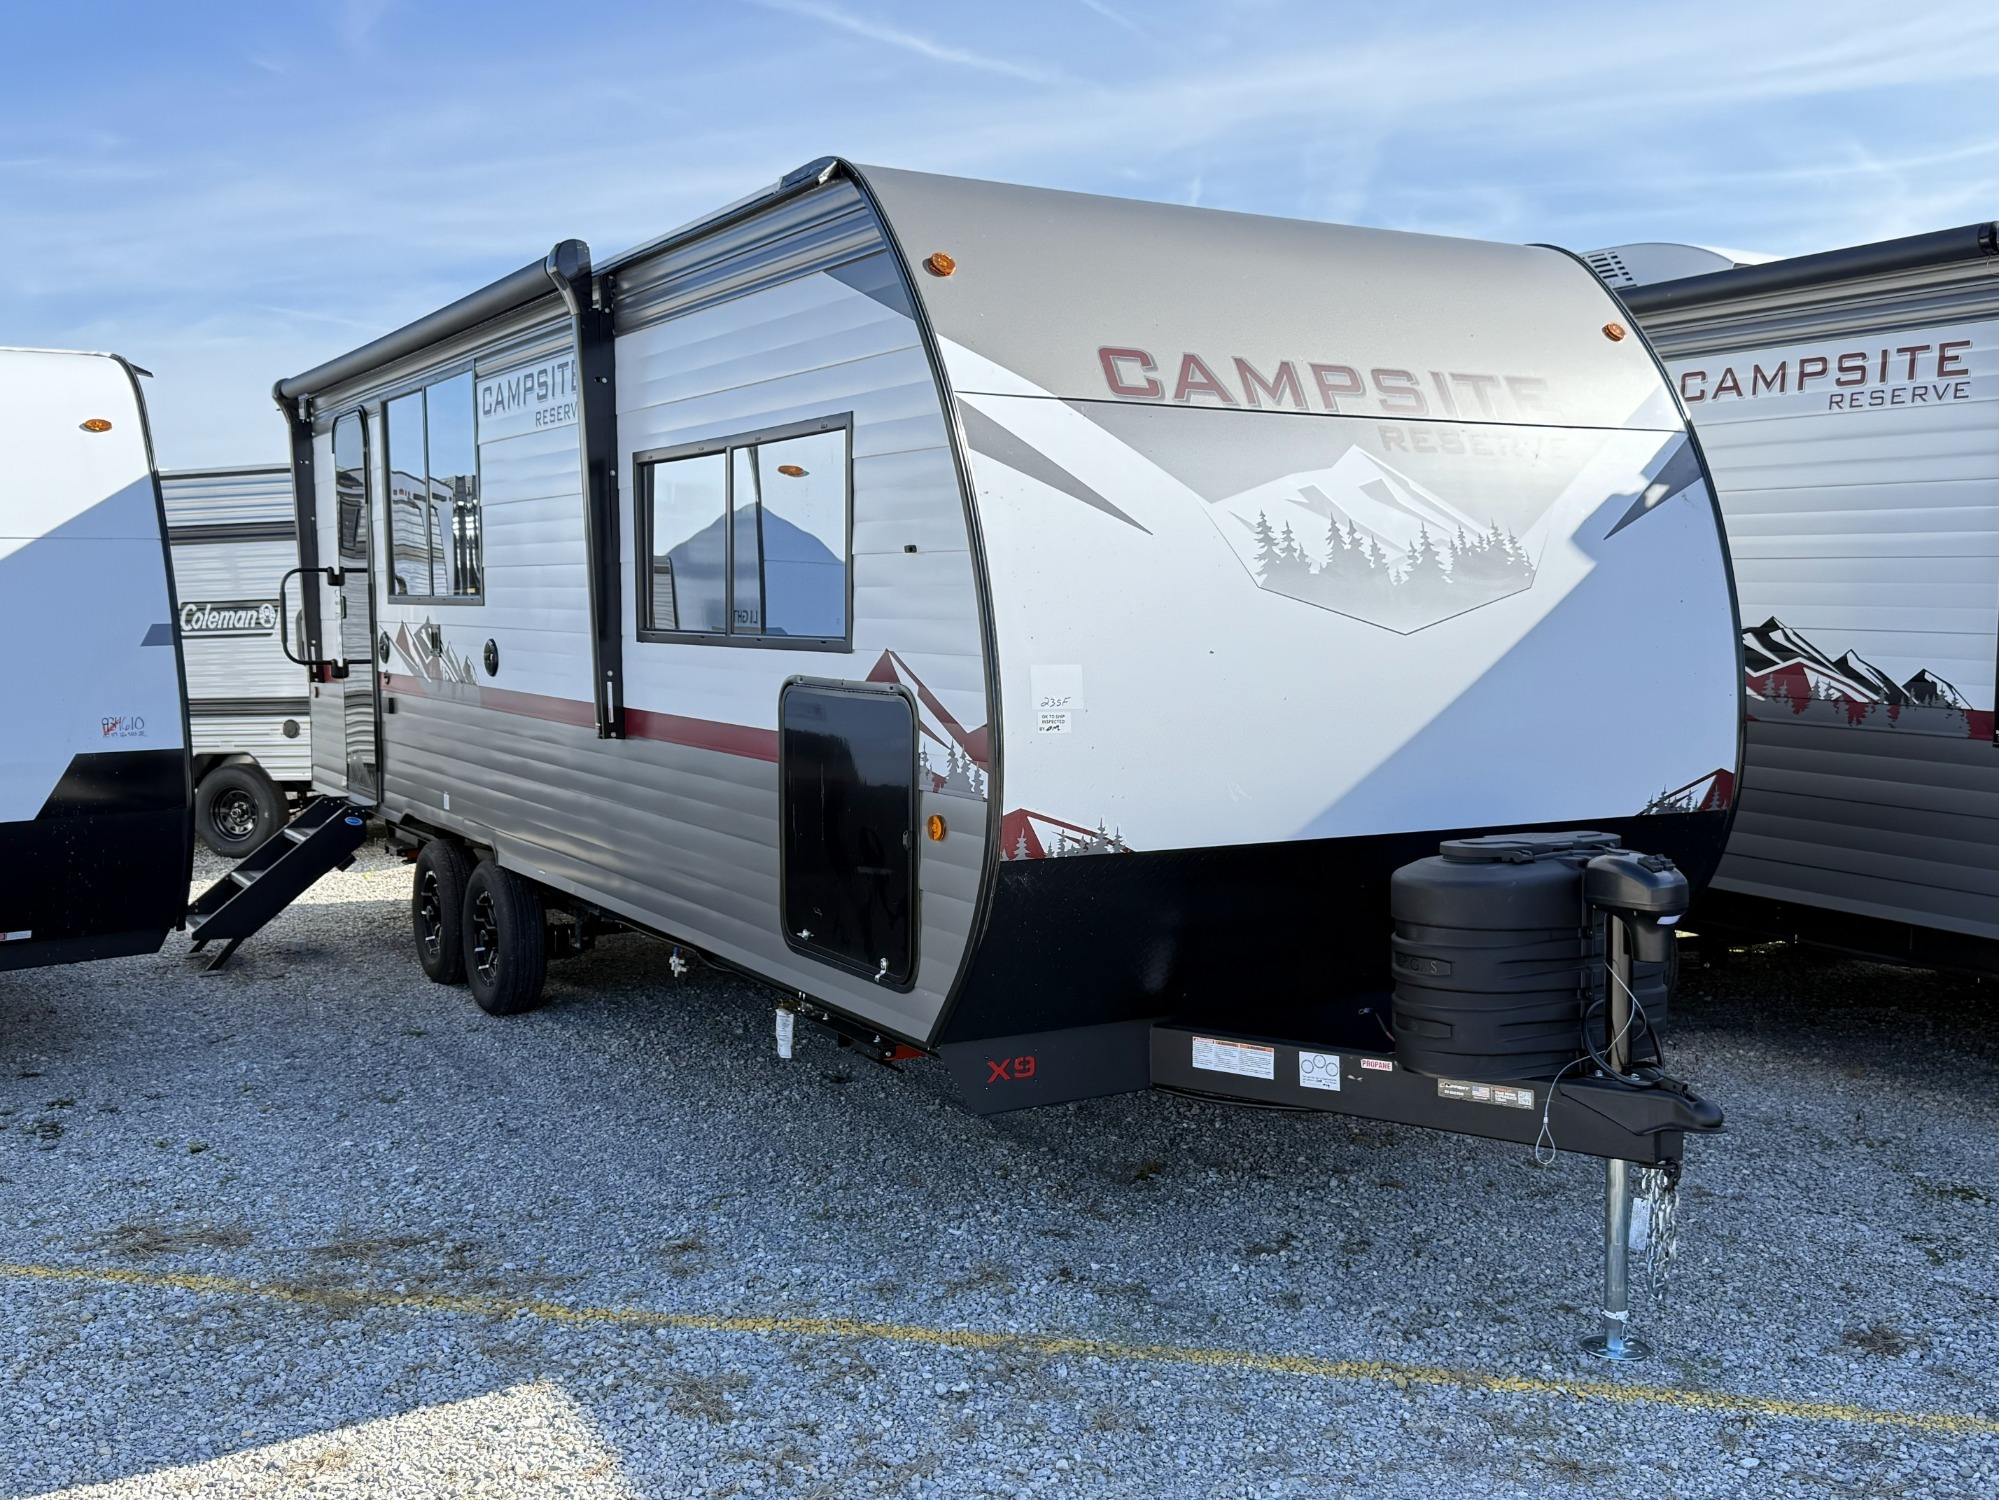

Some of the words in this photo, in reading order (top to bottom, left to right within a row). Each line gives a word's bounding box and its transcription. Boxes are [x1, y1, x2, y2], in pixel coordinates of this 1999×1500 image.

[1098, 346, 1560, 421] CAMPSITE
[1681, 340, 1971, 402] CAMPSITE
[1828, 381, 1971, 411] RESERVE
[535, 402, 578, 428] RESERV
[180, 603, 258, 631] Coleman
[987, 1055, 1036, 1083] X9
[1361, 1060, 1391, 1070] PROPANE
